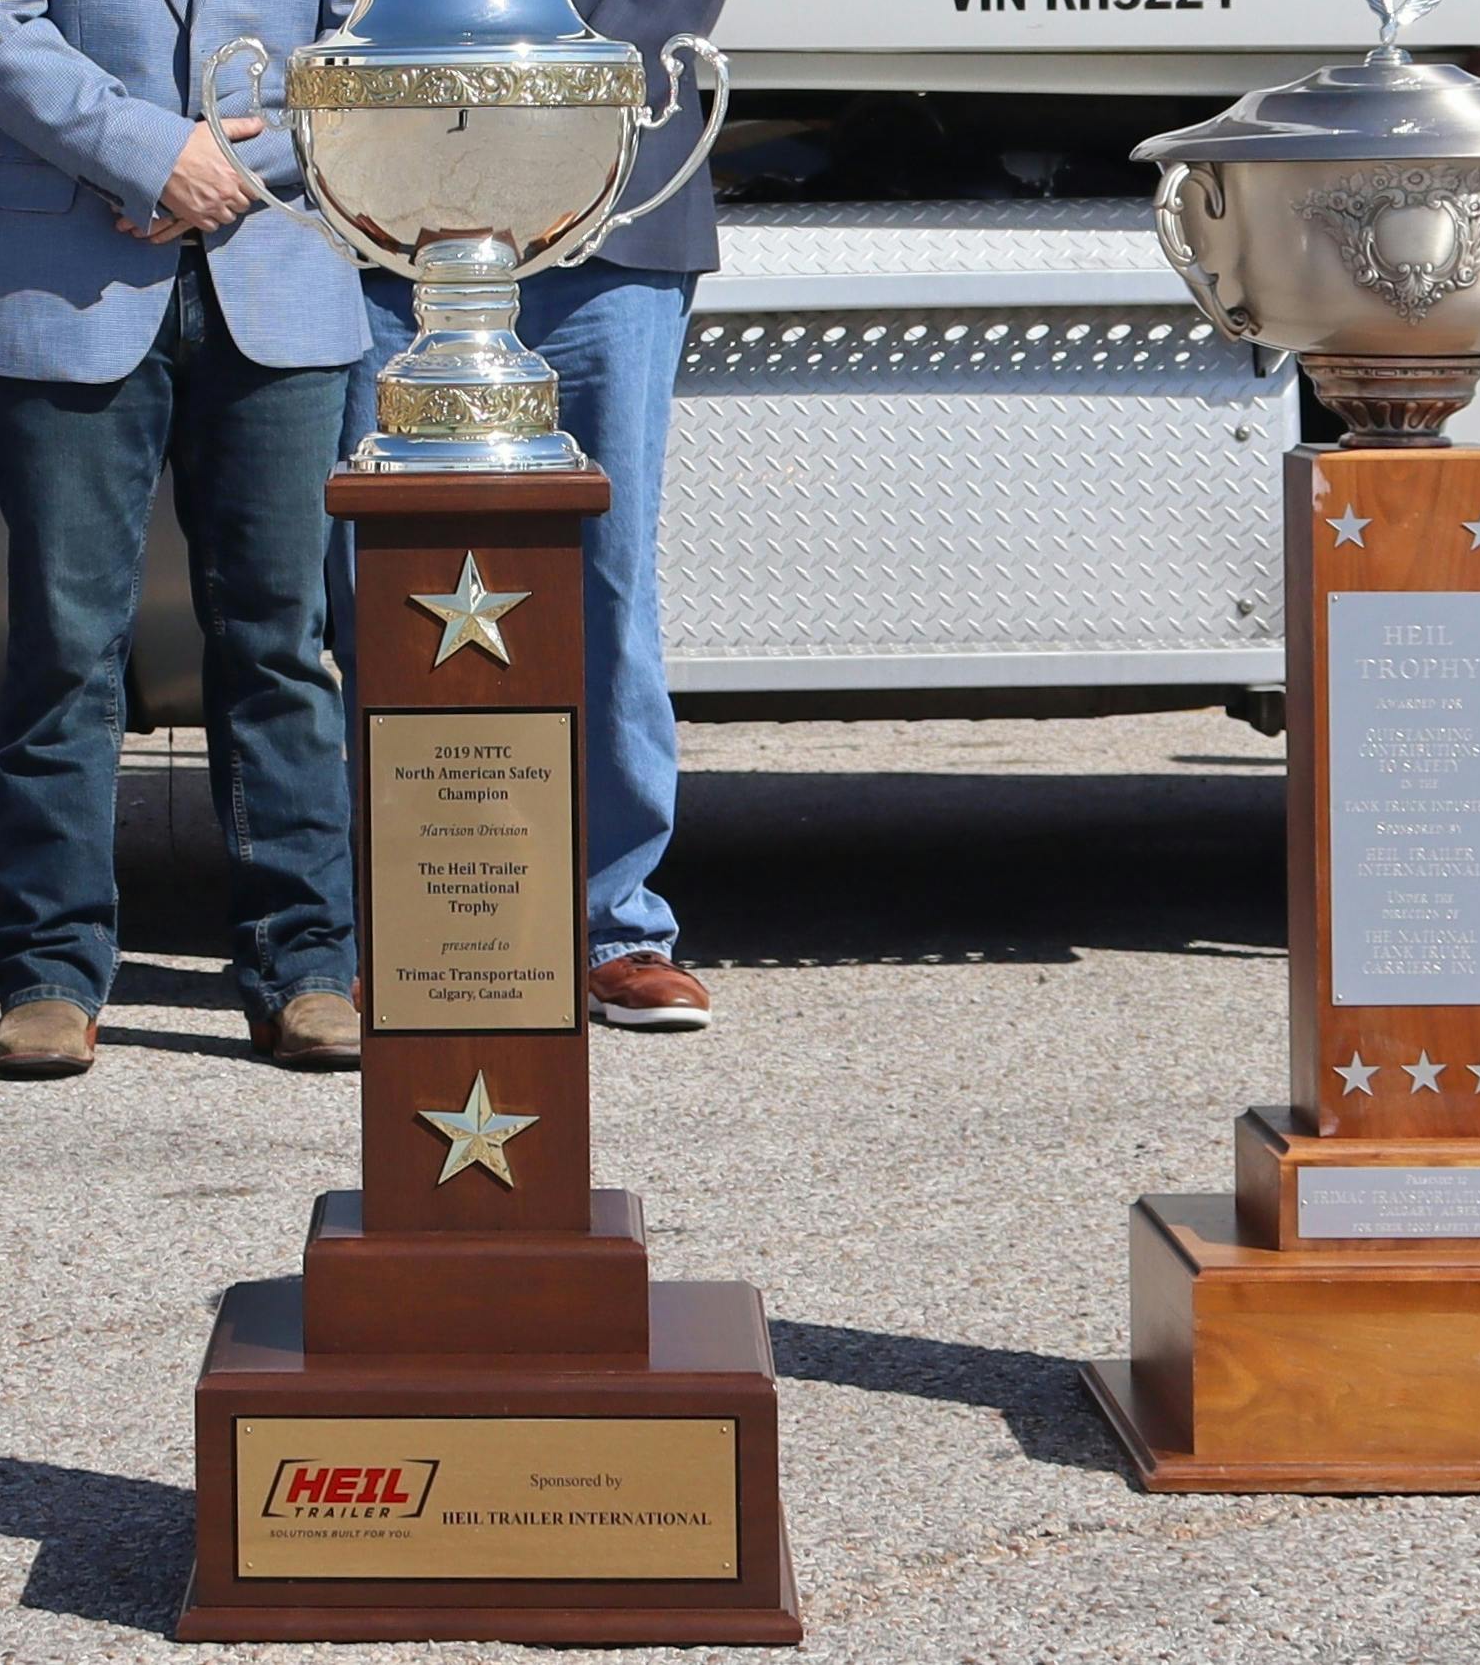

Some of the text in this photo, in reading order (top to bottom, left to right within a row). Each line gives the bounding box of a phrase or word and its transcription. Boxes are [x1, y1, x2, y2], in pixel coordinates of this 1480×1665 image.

[1382, 624, 1453, 646] HEIL
[1355, 658, 1480, 680] TROPHY
[1365, 728, 1474, 741] OUTSTANDING
[435, 746, 512, 759] 2019 NTTC
[1358, 743, 1480, 758] CONTRIBUTIONS
[1378, 759, 1462, 773] TO SAFETY
[395, 766, 552, 782] North American Safety
[438, 788, 509, 803] Champion
[1344, 800, 1380, 813] TANK
[420, 824, 528, 837] Harvison Division
[1365, 847, 1475, 862] HEIL TRAILER
[418, 862, 529, 875] The Heil Trailer
[427, 881, 520, 894] International
[448, 900, 498, 916] Trophy
[1365, 930, 1478, 944] THE NATIONAL
[441, 937, 510, 955] presented to
[1373, 946, 1472, 959] TANK TRUCK
[396, 968, 555, 984] Trimac Transportation
[428, 988, 523, 1002] Calgary, Canada
[1311, 1191, 1368, 1205] TRIMAC
[286, 1468, 410, 1503] HEIL
[530, 1473, 623, 1490] Sponsored by
[294, 1507, 391, 1518] TRAILER
[442, 1511, 712, 1526] HEIL TRAILER INTERNATIONAL
[270, 1529, 327, 1539] SOLUTIONS
[331, 1529, 360, 1539] BUILT
[363, 1529, 385, 1539] FOR
